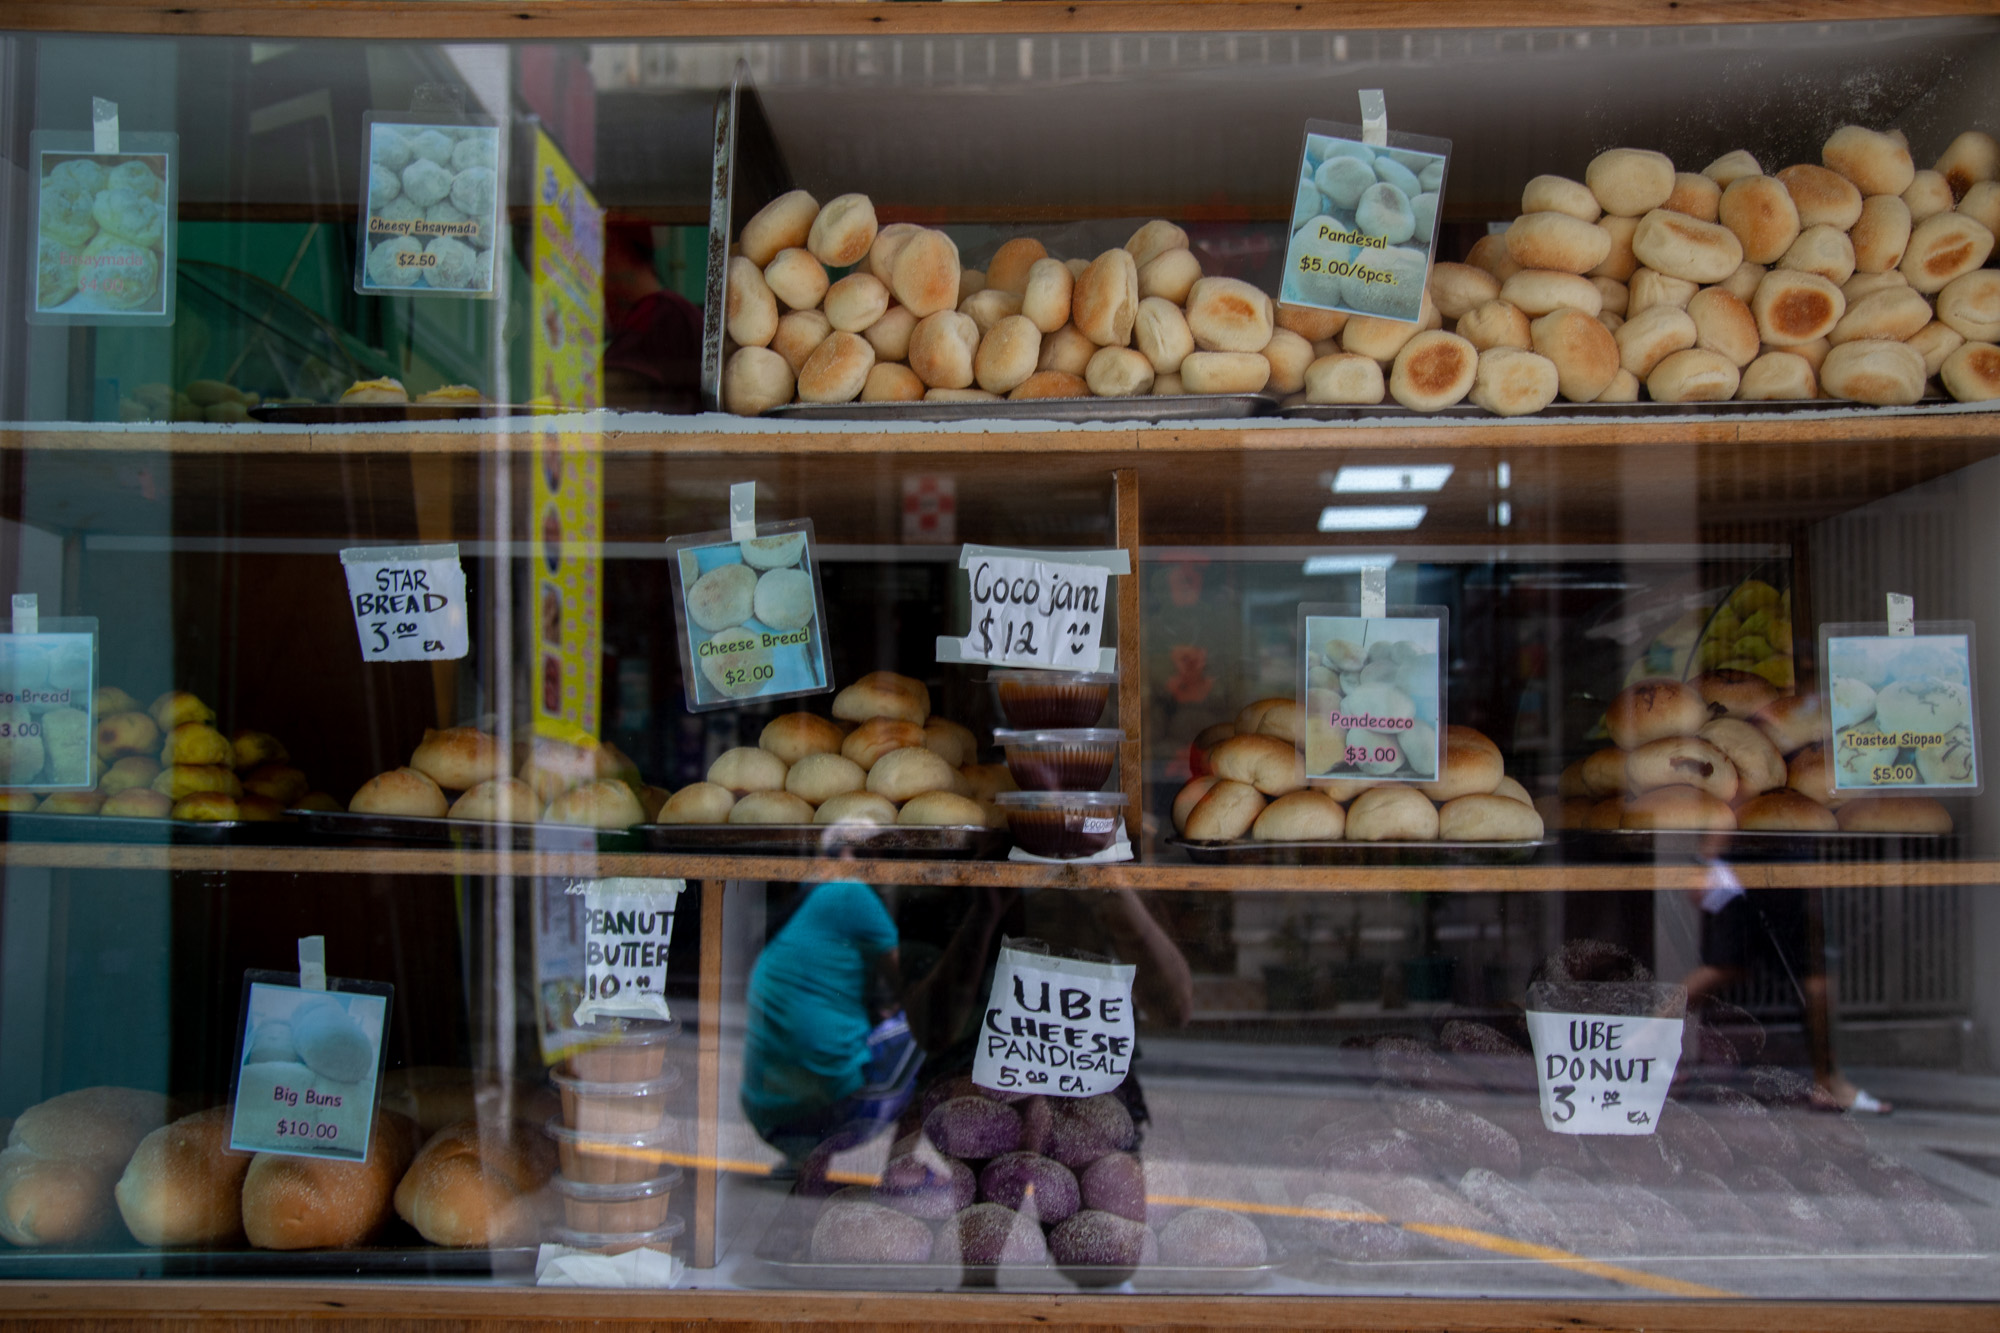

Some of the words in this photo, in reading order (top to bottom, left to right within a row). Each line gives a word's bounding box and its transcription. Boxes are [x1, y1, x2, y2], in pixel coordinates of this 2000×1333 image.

[370, 219, 411, 235] Cheesy
[414, 220, 477, 236] Ensaymada
[1318, 225, 1388, 250] Pandesal
[399, 253, 436, 267] $2.50
[1299, 255, 1398, 286] $5.00/6pcs.
[376, 567, 430, 593] STAR
[973, 562, 1040, 605] Coco
[1038, 573, 1099, 617] jam
[356, 593, 448, 618] BREAD
[699, 638, 755, 657] Cheese
[761, 627, 809, 648] Bread
[971, 608, 1038, 660] $12
[724, 664, 775, 687] $2.00
[22, 688, 70, 704] Bread
[1330, 712, 1414, 729] Pandecoco
[1847, 733, 1897, 747] Toasted
[1901, 732, 1942, 748] Siopao
[1345, 745, 1396, 763] $3.00
[1872, 766, 1914, 781] $5.00
[587, 941, 670, 968] BUTTER
[1013, 974, 1123, 1023] UBE
[985, 1008, 1130, 1057] CHEESE
[1569, 1020, 1624, 1053] UBE
[987, 1035, 1126, 1075] PANDISAL
[1546, 1053, 1656, 1083] DONUT
[273, 1085, 299, 1107] Big
[304, 1089, 342, 1107] Buns
[276, 1118, 338, 1139] $10.00
